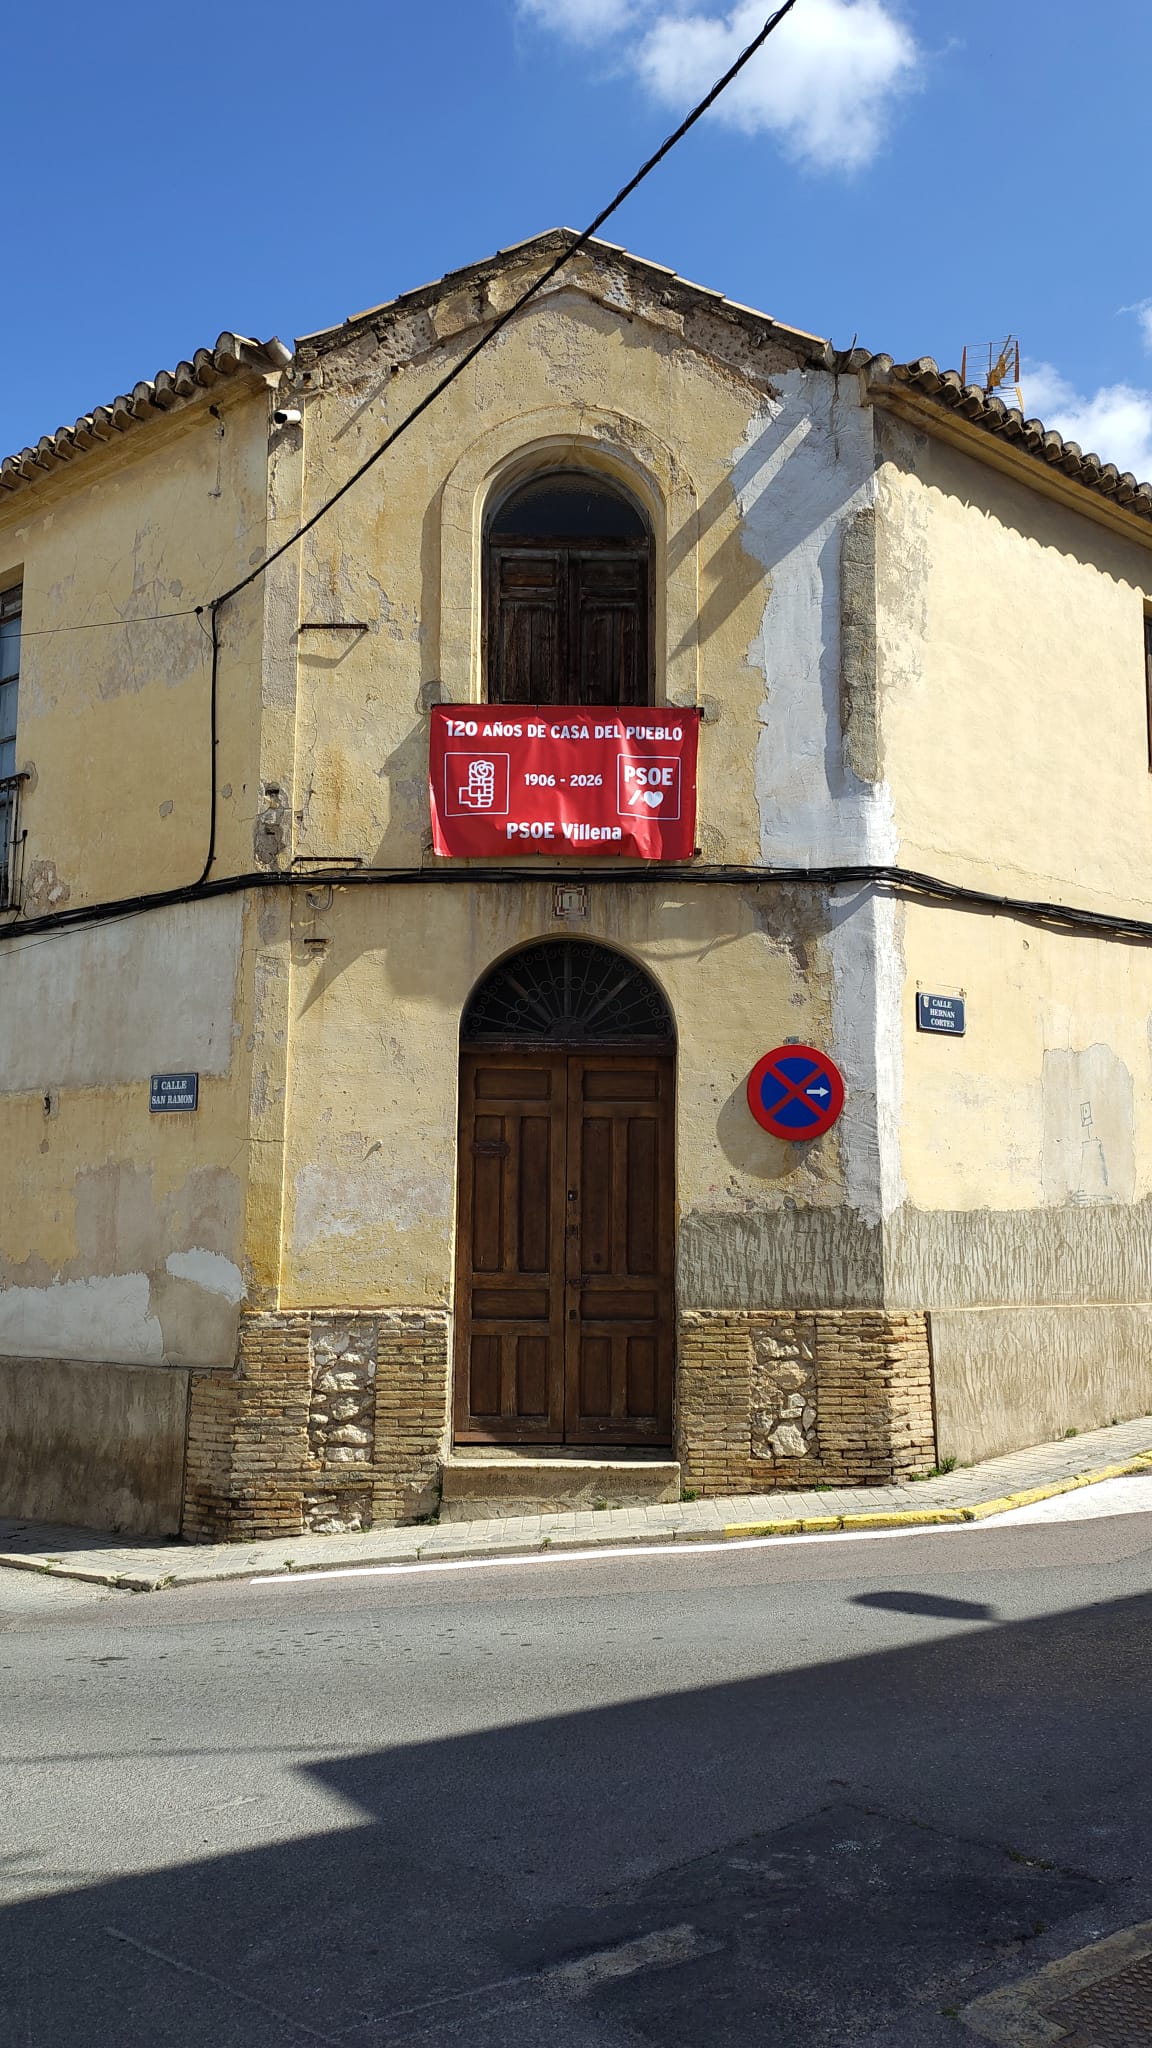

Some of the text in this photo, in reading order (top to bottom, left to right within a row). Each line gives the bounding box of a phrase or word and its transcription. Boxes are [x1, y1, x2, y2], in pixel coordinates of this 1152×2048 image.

[446, 720, 683, 741] 120 AÑOS DE CASA DEL PUEBLO
[524, 773, 556, 786] 1906
[570, 774, 603, 787] 2026
[624, 765, 673, 786] PSOE
[506, 822, 622, 841] PSOE Villena
[932, 999, 952, 1008] CALLE
[929, 1008, 955, 1018] HERNAN
[930, 1018, 955, 1028] CORTES
[161, 1080, 187, 1090] CALLE
[151, 1094, 193, 1104] SAN RAMON
